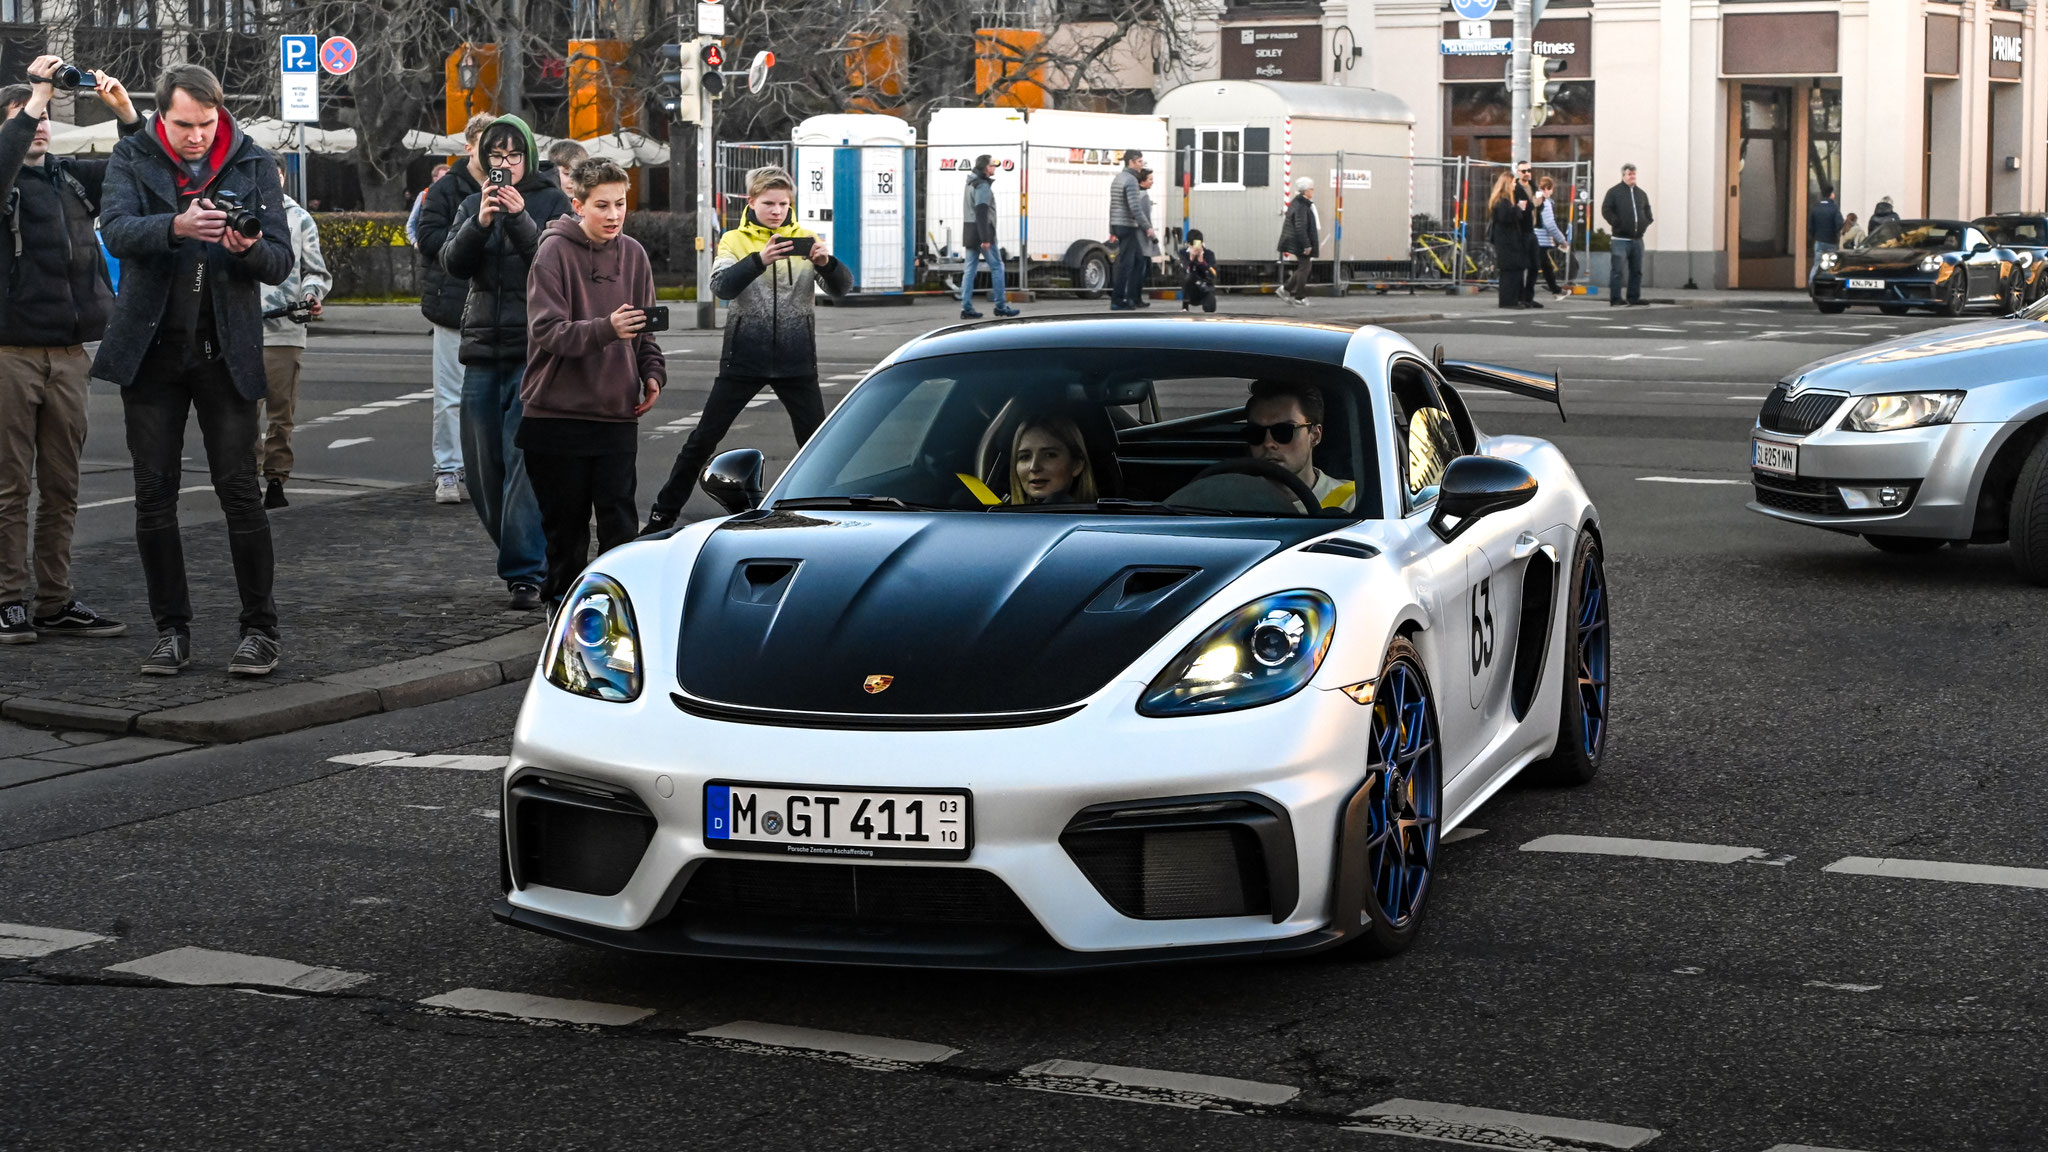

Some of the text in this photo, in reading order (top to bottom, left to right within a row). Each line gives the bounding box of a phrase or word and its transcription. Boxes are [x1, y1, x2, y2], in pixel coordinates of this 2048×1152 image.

[287, 40, 306, 68] P
[1255, 49, 1283, 57] SIDLEY
[1533, 41, 1575, 54] fitness
[1992, 35, 2022, 62] PRIME
[1256, 65, 1283, 77] Regus
[940, 158, 1014, 171] MAO
[811, 169, 824, 181] TOI
[877, 170, 893, 183] TOI
[811, 181, 824, 192] TOI
[877, 183, 893, 194] TOI
[192, 263, 204, 292] LUMIX
[1757, 444, 1764, 464] SL
[1472, 576, 1494, 677] 63
[940, 800, 957, 813] 03
[714, 818, 723, 829] D
[732, 792, 930, 842] M GT 411
[941, 830, 957, 842] 10
[787, 845, 809, 853] Porsche
[833, 847, 874, 857] Aschaffenburg
